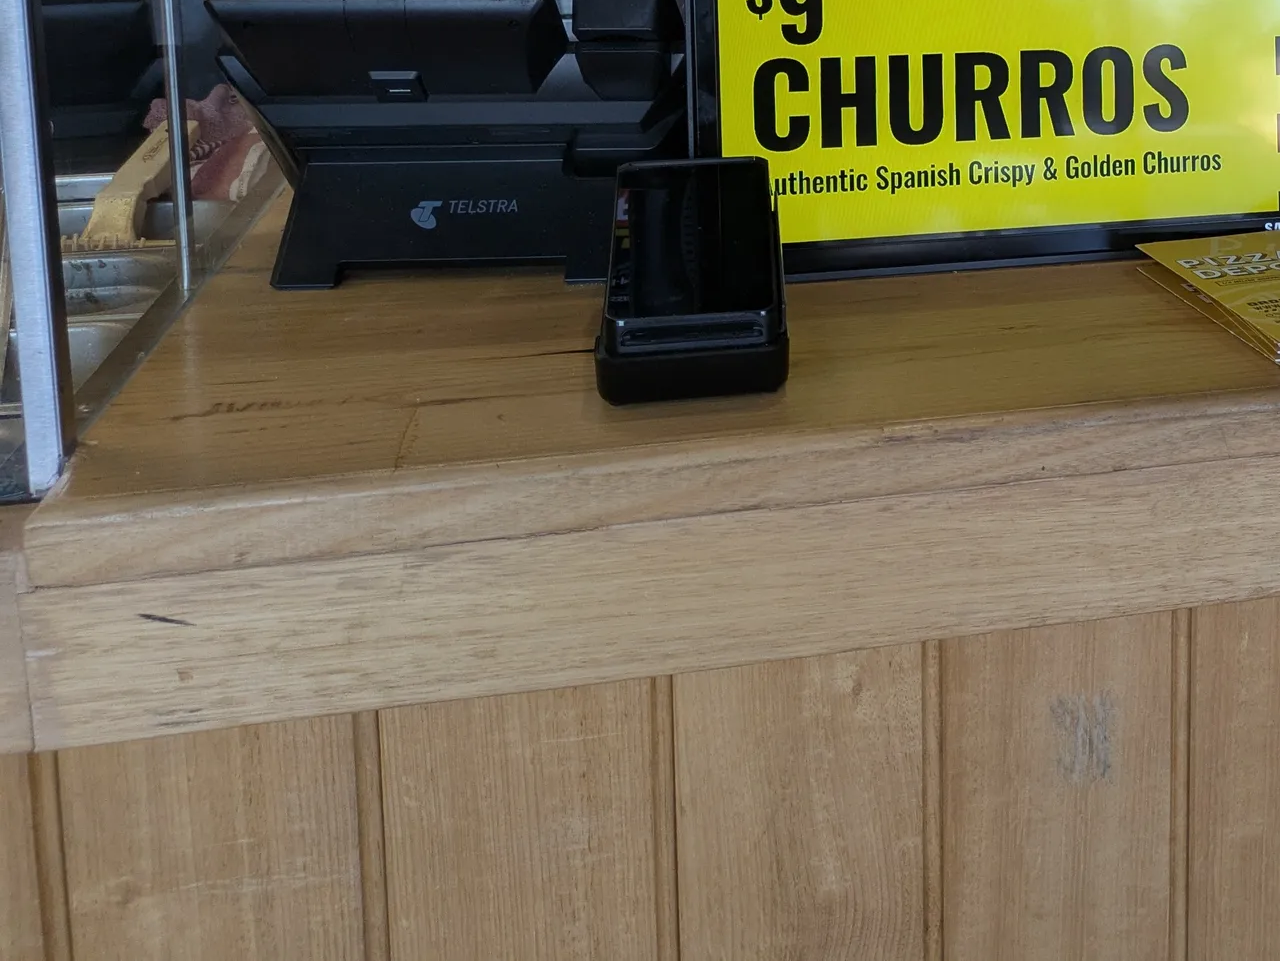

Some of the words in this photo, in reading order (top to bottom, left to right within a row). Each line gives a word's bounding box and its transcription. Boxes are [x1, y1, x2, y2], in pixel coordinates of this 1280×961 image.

[753, 43, 1190, 152] CHURROS
[769, 168, 868, 196] uthentic
[876, 162, 961, 195] Spanish
[969, 160, 1036, 188] Crispy
[1043, 156, 1058, 181] &
[1065, 154, 1136, 179] Golden
[1143, 151, 1222, 175] Churros
[449, 199, 518, 214] TELSTRA
